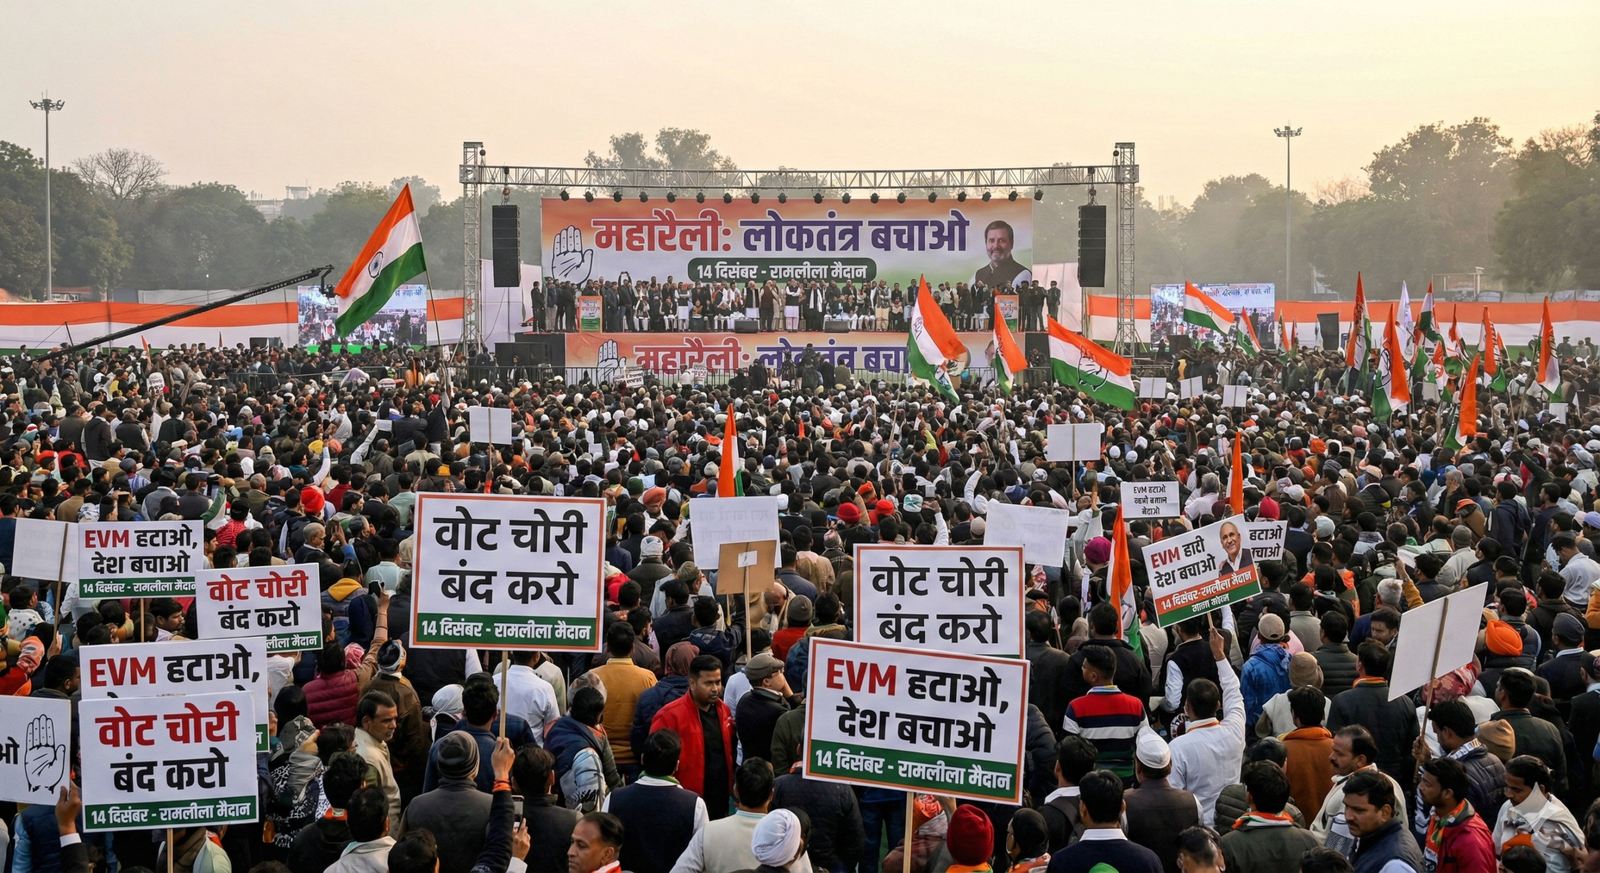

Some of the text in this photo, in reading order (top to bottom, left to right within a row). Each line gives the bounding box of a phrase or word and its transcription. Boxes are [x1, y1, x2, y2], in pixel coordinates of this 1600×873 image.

[592, 209, 970, 252] महारैली: लोकतंत्र बचाओ
[697, 265, 712, 279] 14
[715, 261, 757, 279] दिसंबर
[769, 260, 829, 279] रामलीला
[831, 260, 867, 279] मैदान
[862, 346, 911, 374] बचा
[1133, 486, 1147, 494] EVM
[85, 524, 198, 549] EVM हटाओ,
[433, 505, 588, 555] वोट चोरी
[91, 549, 191, 574] देश बचाओ
[1150, 546, 1181, 569] EVM
[1154, 553, 1217, 588] देश बचाओ
[83, 584, 94, 594] 14
[133, 580, 173, 592] रामलीला
[206, 569, 309, 602] वोट चोरी
[438, 558, 580, 606] बंद करो
[869, 555, 1009, 597] वोट चोरी
[218, 600, 300, 631] बंद करो
[1161, 599, 1172, 611] 14
[421, 619, 438, 636] 14
[439, 616, 482, 638] दिसंबर
[494, 618, 552, 640] रामलीला
[554, 618, 591, 641] मैदान
[876, 603, 1002, 644] बंद करो
[266, 633, 318, 649] लीला मैदान
[90, 643, 260, 687] EVM हटाओ,
[826, 657, 1010, 715] EVM हटाओ,
[95, 700, 240, 748] वोट चोरी
[836, 696, 996, 753] देश बचाओ
[110, 747, 229, 793] बंद करो
[815, 749, 833, 768] 14
[836, 747, 885, 775] दिसंबर
[897, 760, 966, 785] रामलीला
[968, 763, 1013, 791] मैदान
[91, 810, 106, 825] 14
[108, 806, 149, 824] दिसंबर
[159, 802, 214, 821] रामलीला
[216, 800, 251, 818] मैदान
